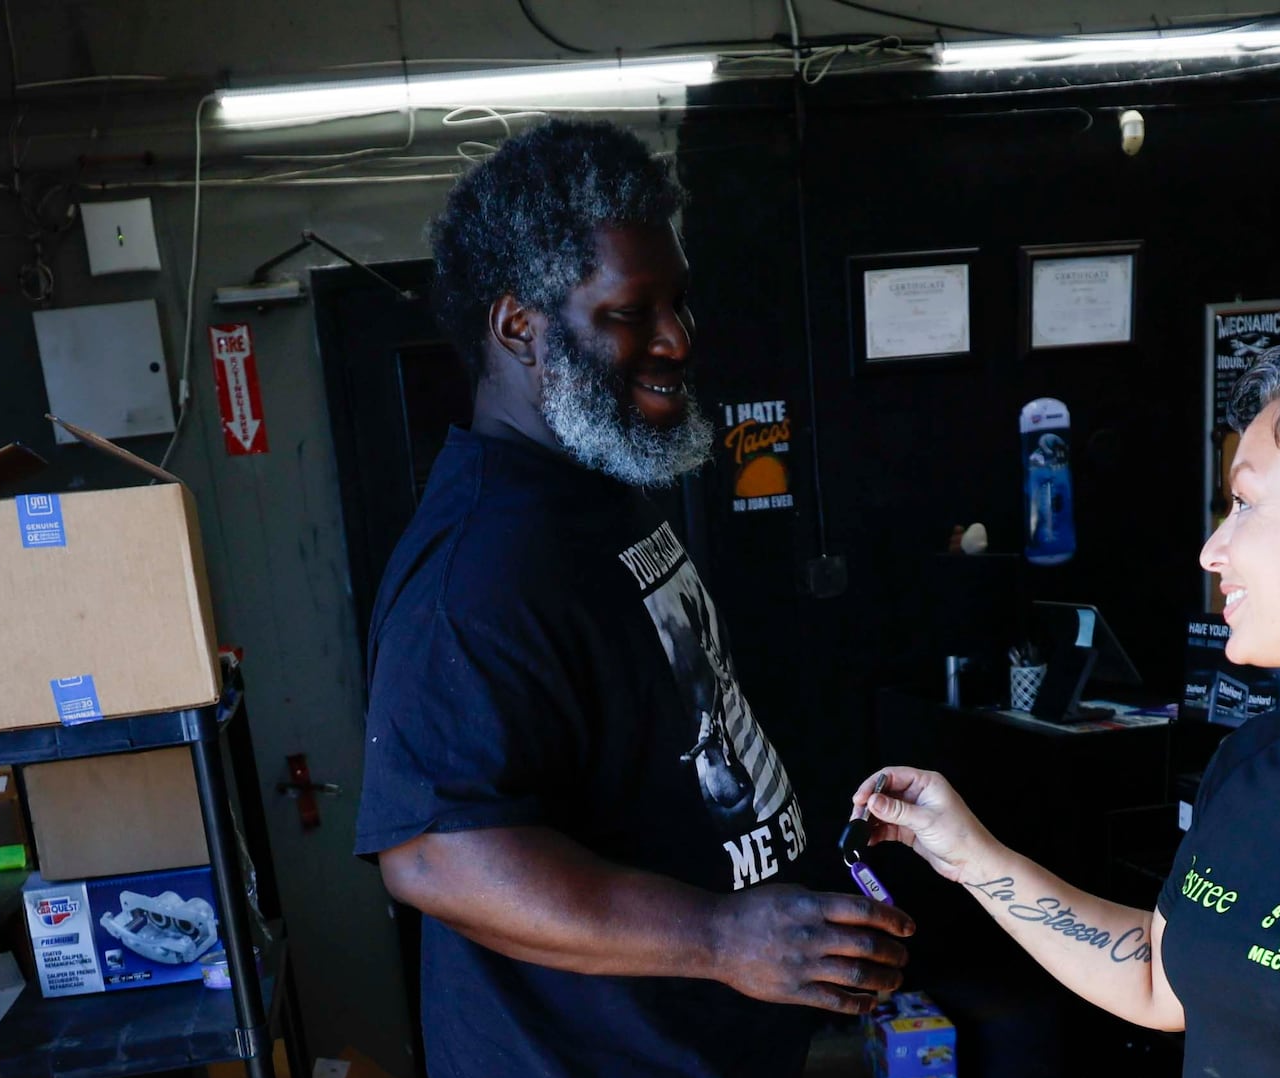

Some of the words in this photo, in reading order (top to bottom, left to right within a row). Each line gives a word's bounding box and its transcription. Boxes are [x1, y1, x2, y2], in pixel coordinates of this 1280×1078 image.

[217, 335, 245, 353] FIRE
[230, 356, 249, 441] EXTINGUISHER
[725, 404, 733, 427] I
[737, 400, 787, 424] HATE
[724, 419, 792, 464] Tacos
[26, 521, 60, 531] GENUINE
[1188, 621, 1208, 636] HAVE
[1209, 624, 1228, 638] YOUR
[723, 825, 778, 890] ME
[37, 902, 78, 914] CARQUEST
